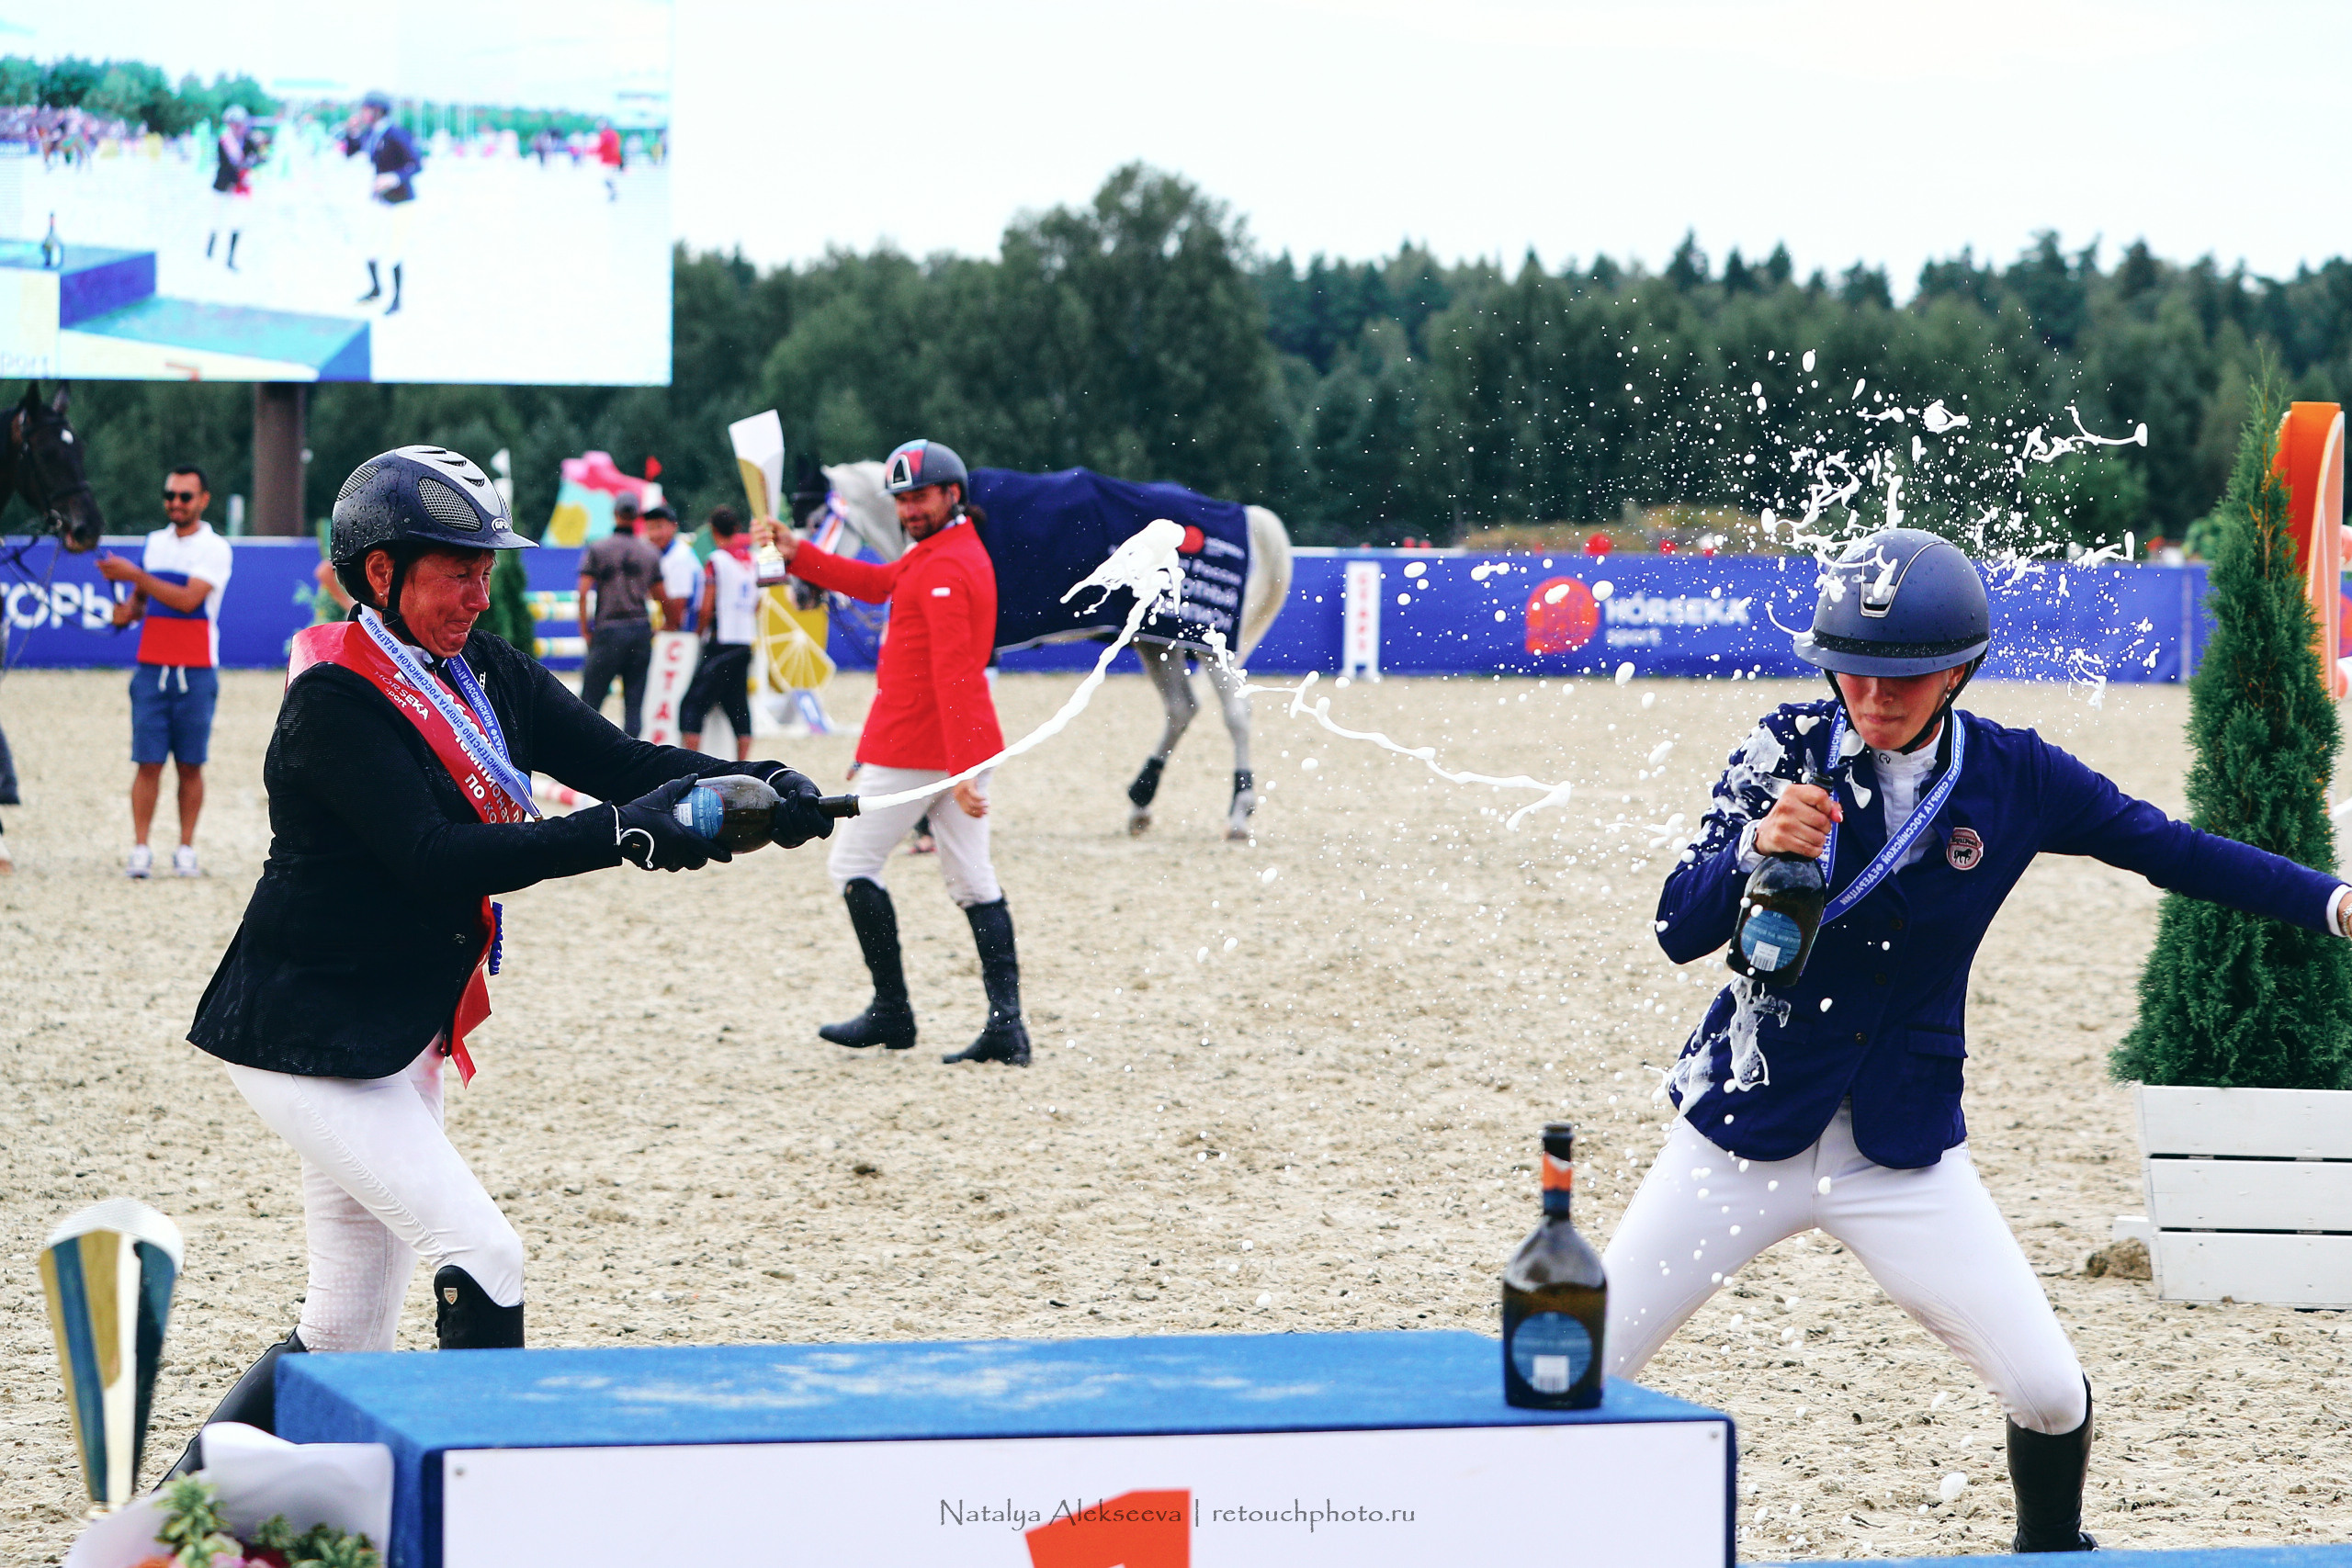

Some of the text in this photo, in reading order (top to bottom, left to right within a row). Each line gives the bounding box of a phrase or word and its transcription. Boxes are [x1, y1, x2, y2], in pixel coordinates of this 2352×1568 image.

[365, 616, 399, 654] ФЕДЕРАЦИИ
[396, 653, 441, 700] РОССИЙСКОЙ
[438, 698, 464, 728] СПОРТА
[463, 728, 511, 784] МИНИСТЕРСТВО
